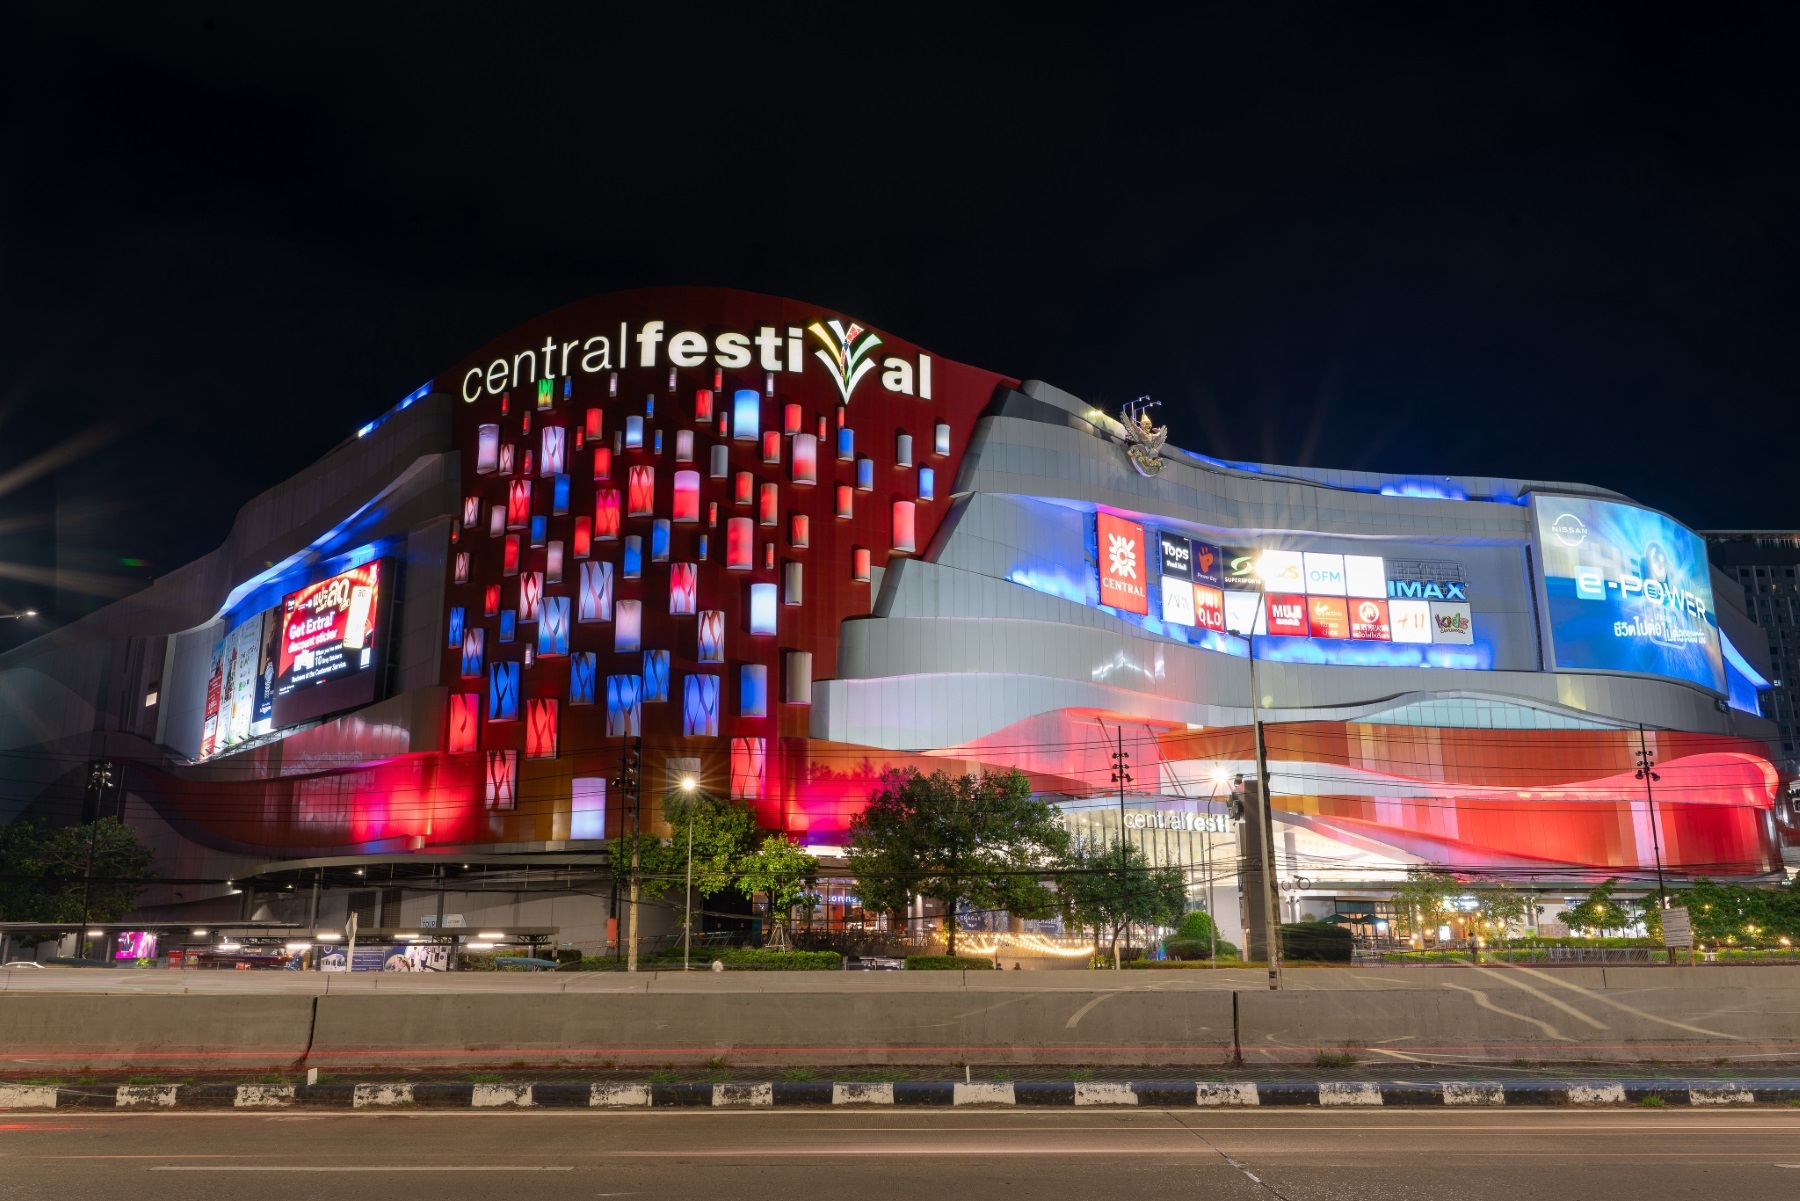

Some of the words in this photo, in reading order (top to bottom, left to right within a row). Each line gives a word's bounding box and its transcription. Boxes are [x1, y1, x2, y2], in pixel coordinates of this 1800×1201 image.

[1551, 525, 1588, 535] NISSAN
[1161, 540, 1189, 561] Tops
[1224, 576, 1262, 585] SUPERSPORTS
[1310, 570, 1341, 583] OFM
[1102, 576, 1146, 598] CENTRAL
[1387, 580, 1466, 600] IMAX
[1197, 589, 1218, 608] UNI
[1198, 608, 1221, 627] QLO
[1272, 604, 1302, 619] MUJI
[289, 624, 305, 640] Get
[288, 635, 315, 653] discount
